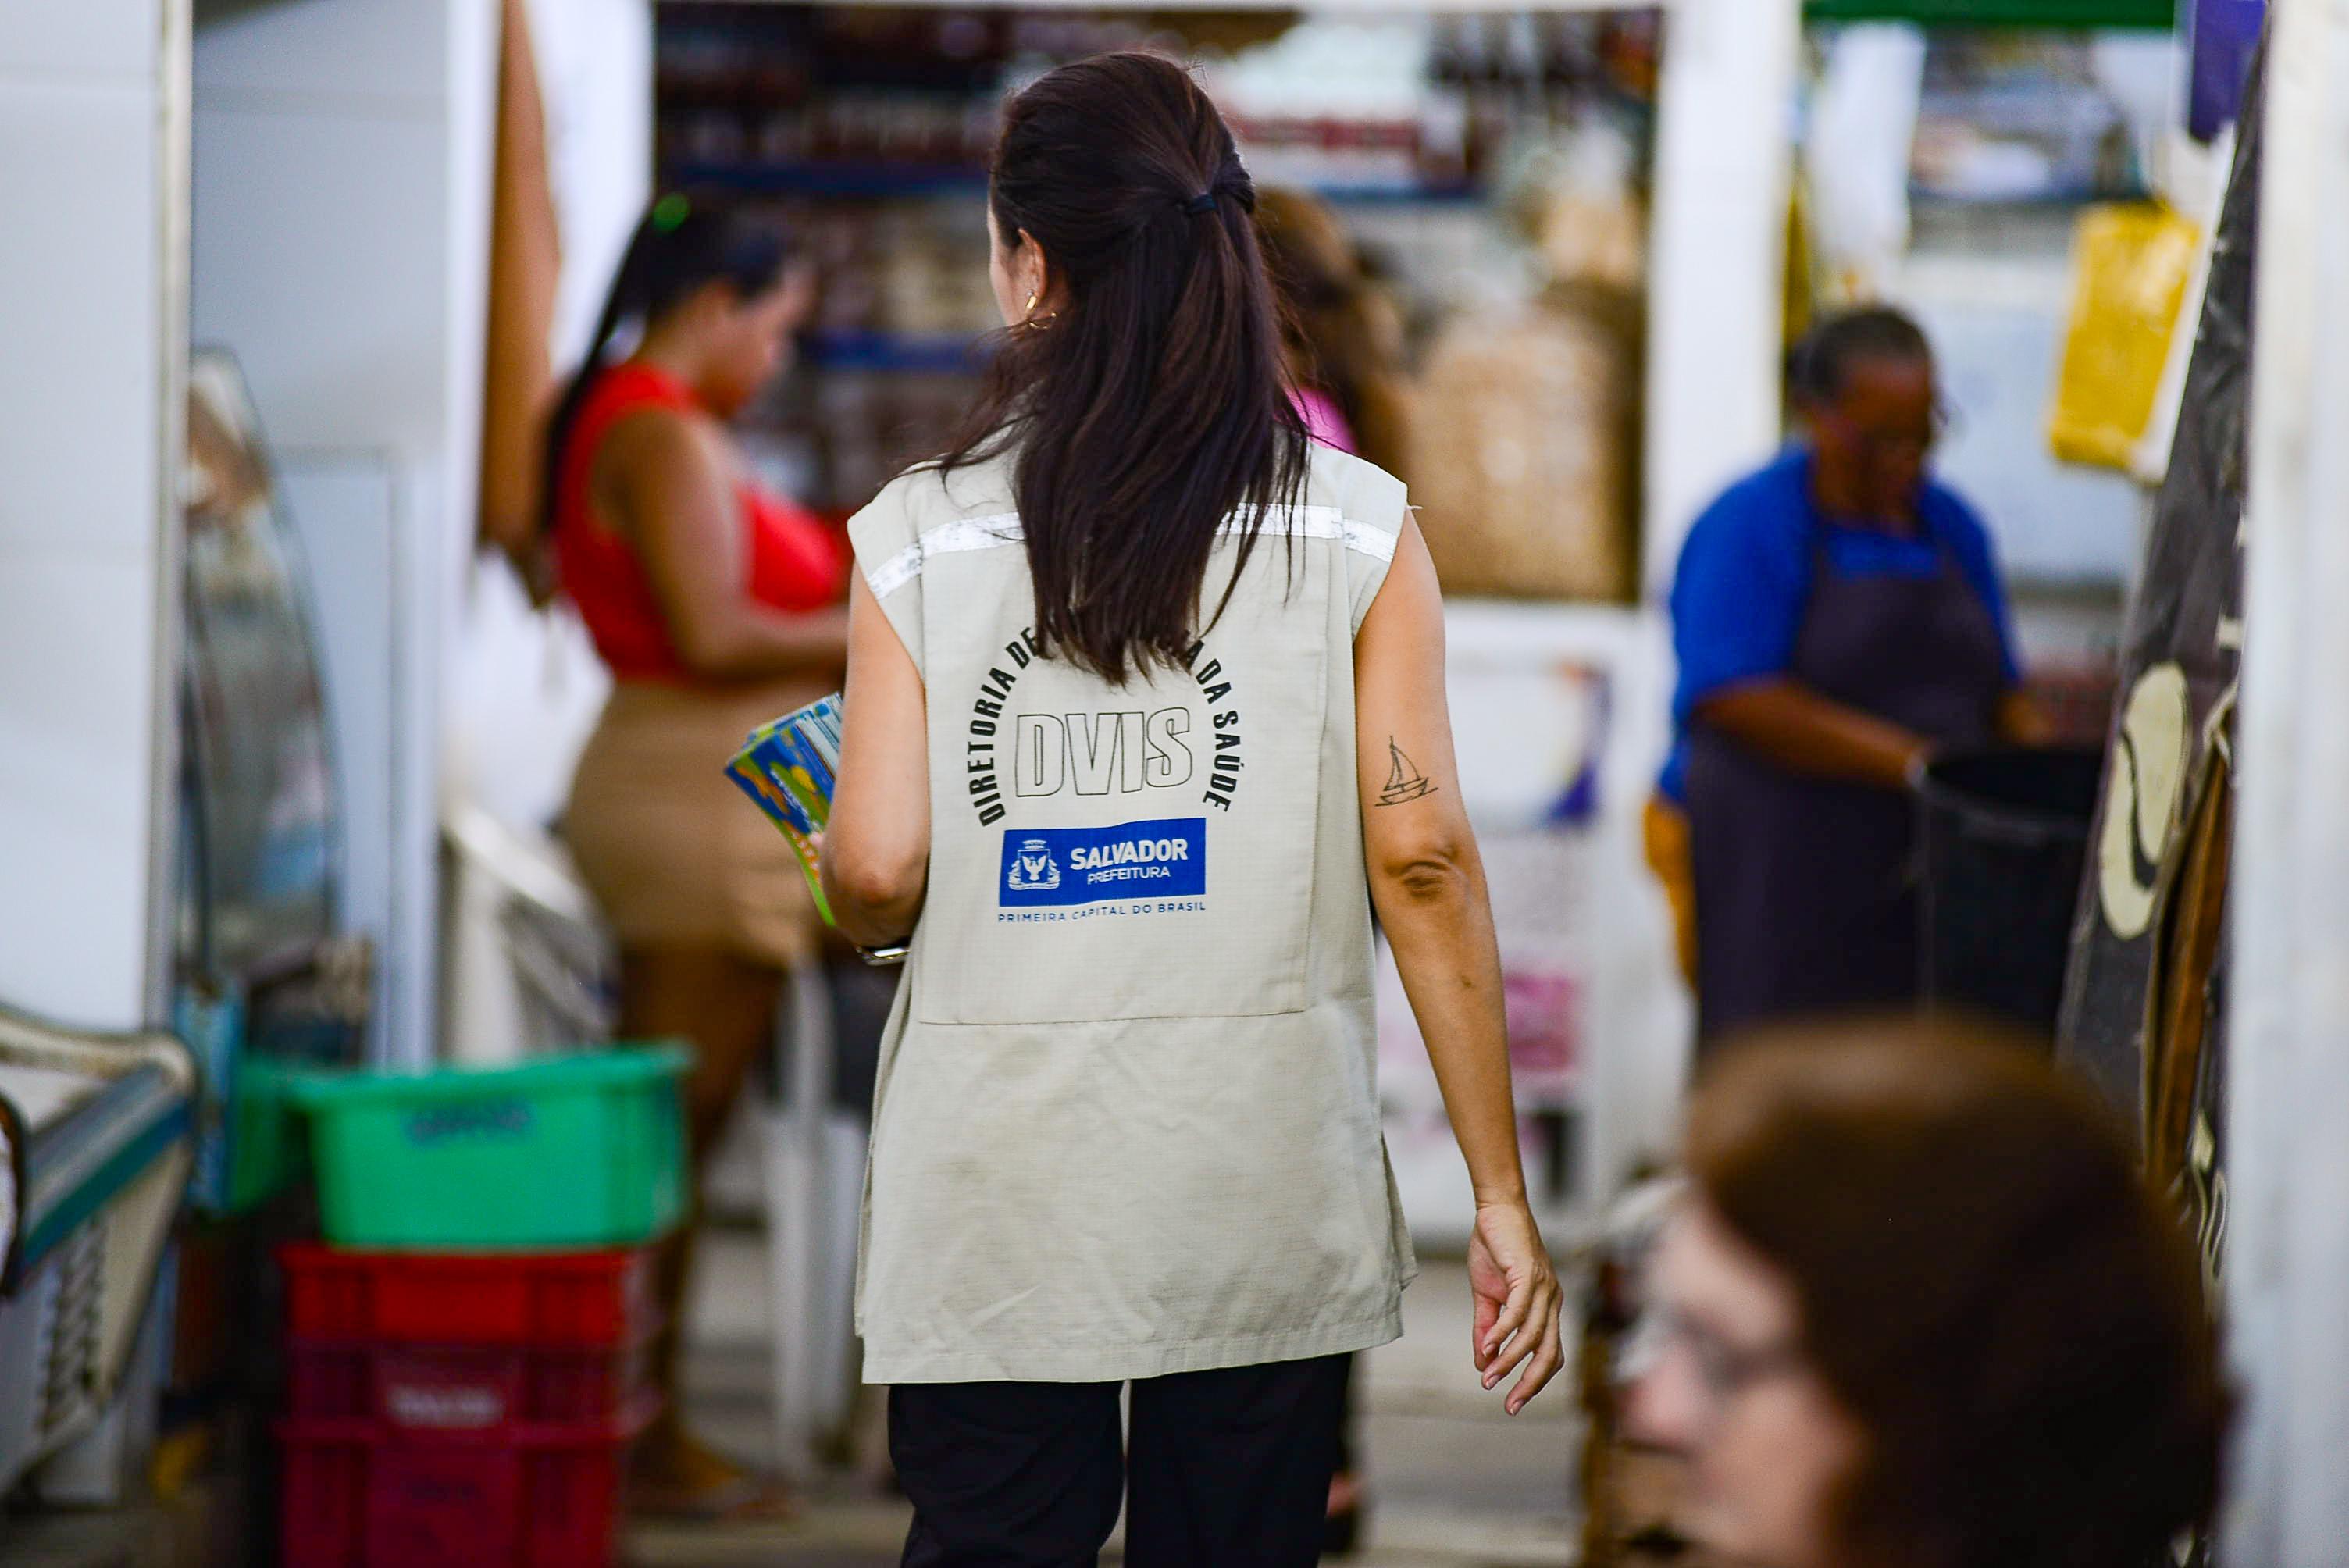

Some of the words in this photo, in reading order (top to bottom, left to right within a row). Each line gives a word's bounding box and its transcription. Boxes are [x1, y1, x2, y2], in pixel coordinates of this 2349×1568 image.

[1196, 658, 1232, 704] DA
[968, 668, 1016, 827] DIRETORIA
[1015, 707, 1192, 797] DVIS
[1203, 710, 1245, 812] SAÚDE
[1070, 838, 1188, 871] SALVADOR
[1086, 865, 1171, 885] PREFEITURA
[998, 912, 1066, 923] PRIMEIRA
[1071, 906, 1126, 920] CAPITAL
[1132, 903, 1152, 914] DO
[1158, 901, 1207, 913] BRASIL
